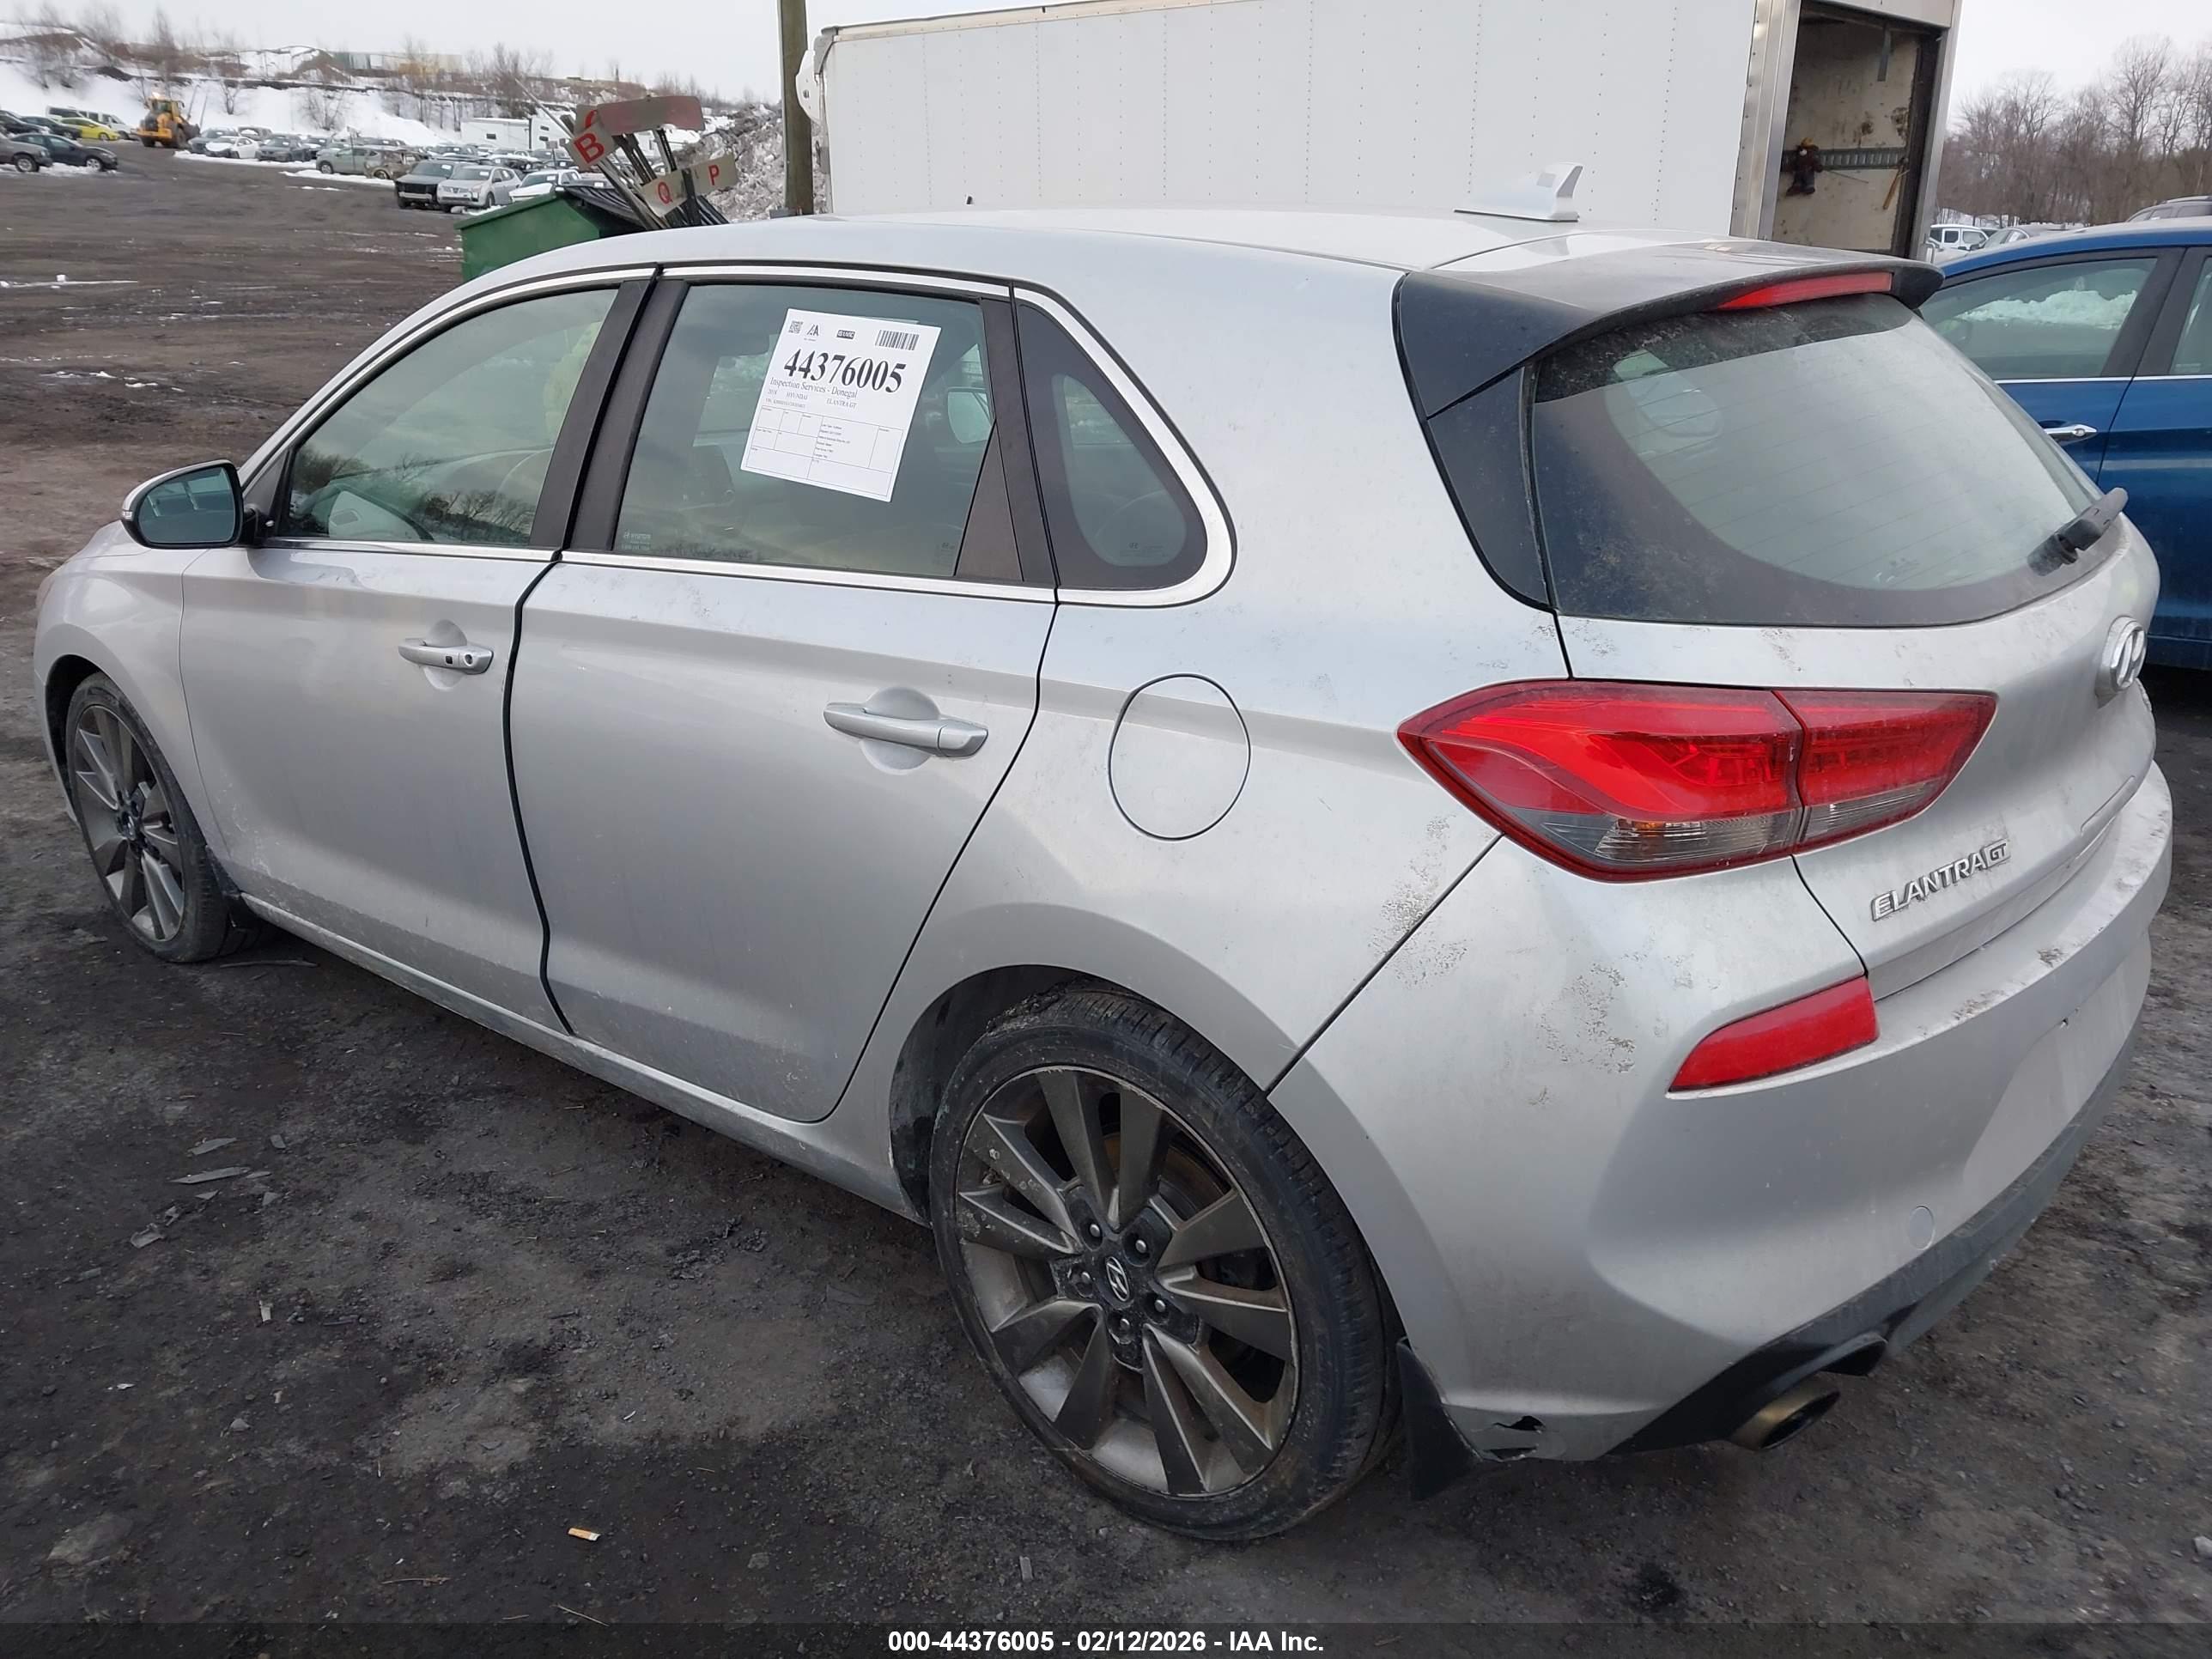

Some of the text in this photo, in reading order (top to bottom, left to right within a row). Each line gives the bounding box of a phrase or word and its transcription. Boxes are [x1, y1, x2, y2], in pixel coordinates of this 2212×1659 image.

[573, 132, 605, 164] B
[708, 164, 720, 185] P
[657, 181, 673, 204] Q
[783, 348, 907, 393] 44376005
[769, 377, 799, 389] Inspection
[800, 381, 826, 393] Services
[831, 386, 858, 399] Donegal
[1870, 852, 1986, 921] ELANTRA
